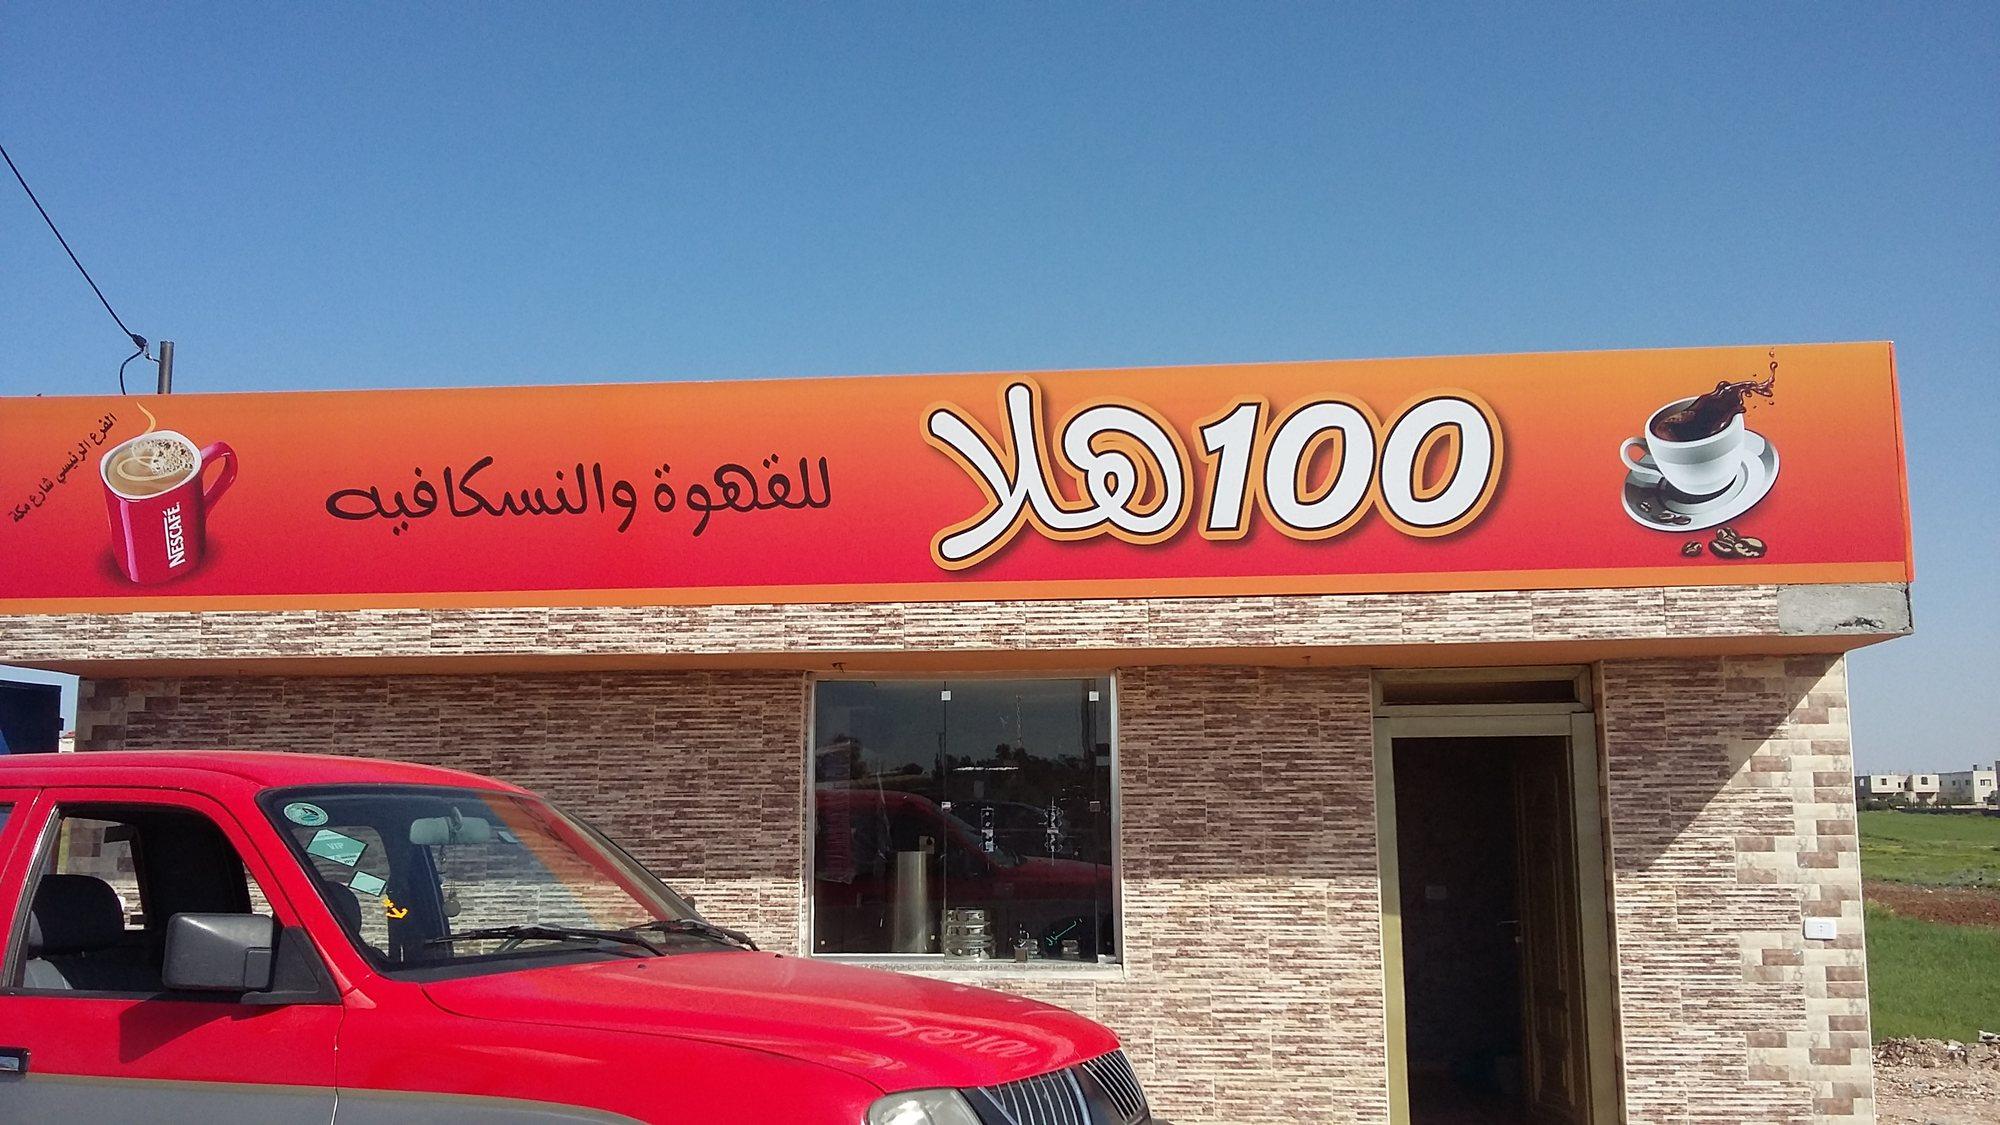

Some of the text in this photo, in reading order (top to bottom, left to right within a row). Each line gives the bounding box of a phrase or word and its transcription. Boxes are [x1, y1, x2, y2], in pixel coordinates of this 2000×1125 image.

[8, 412, 118, 522] الفرع الرئيسي شارع مكة
[324, 452, 833, 538] للقهوة والنسكافيه
[926, 381, 1496, 563] 100 هلا
[162, 502, 186, 568] NESCAFÉ
[326, 842, 345, 851] VIP
